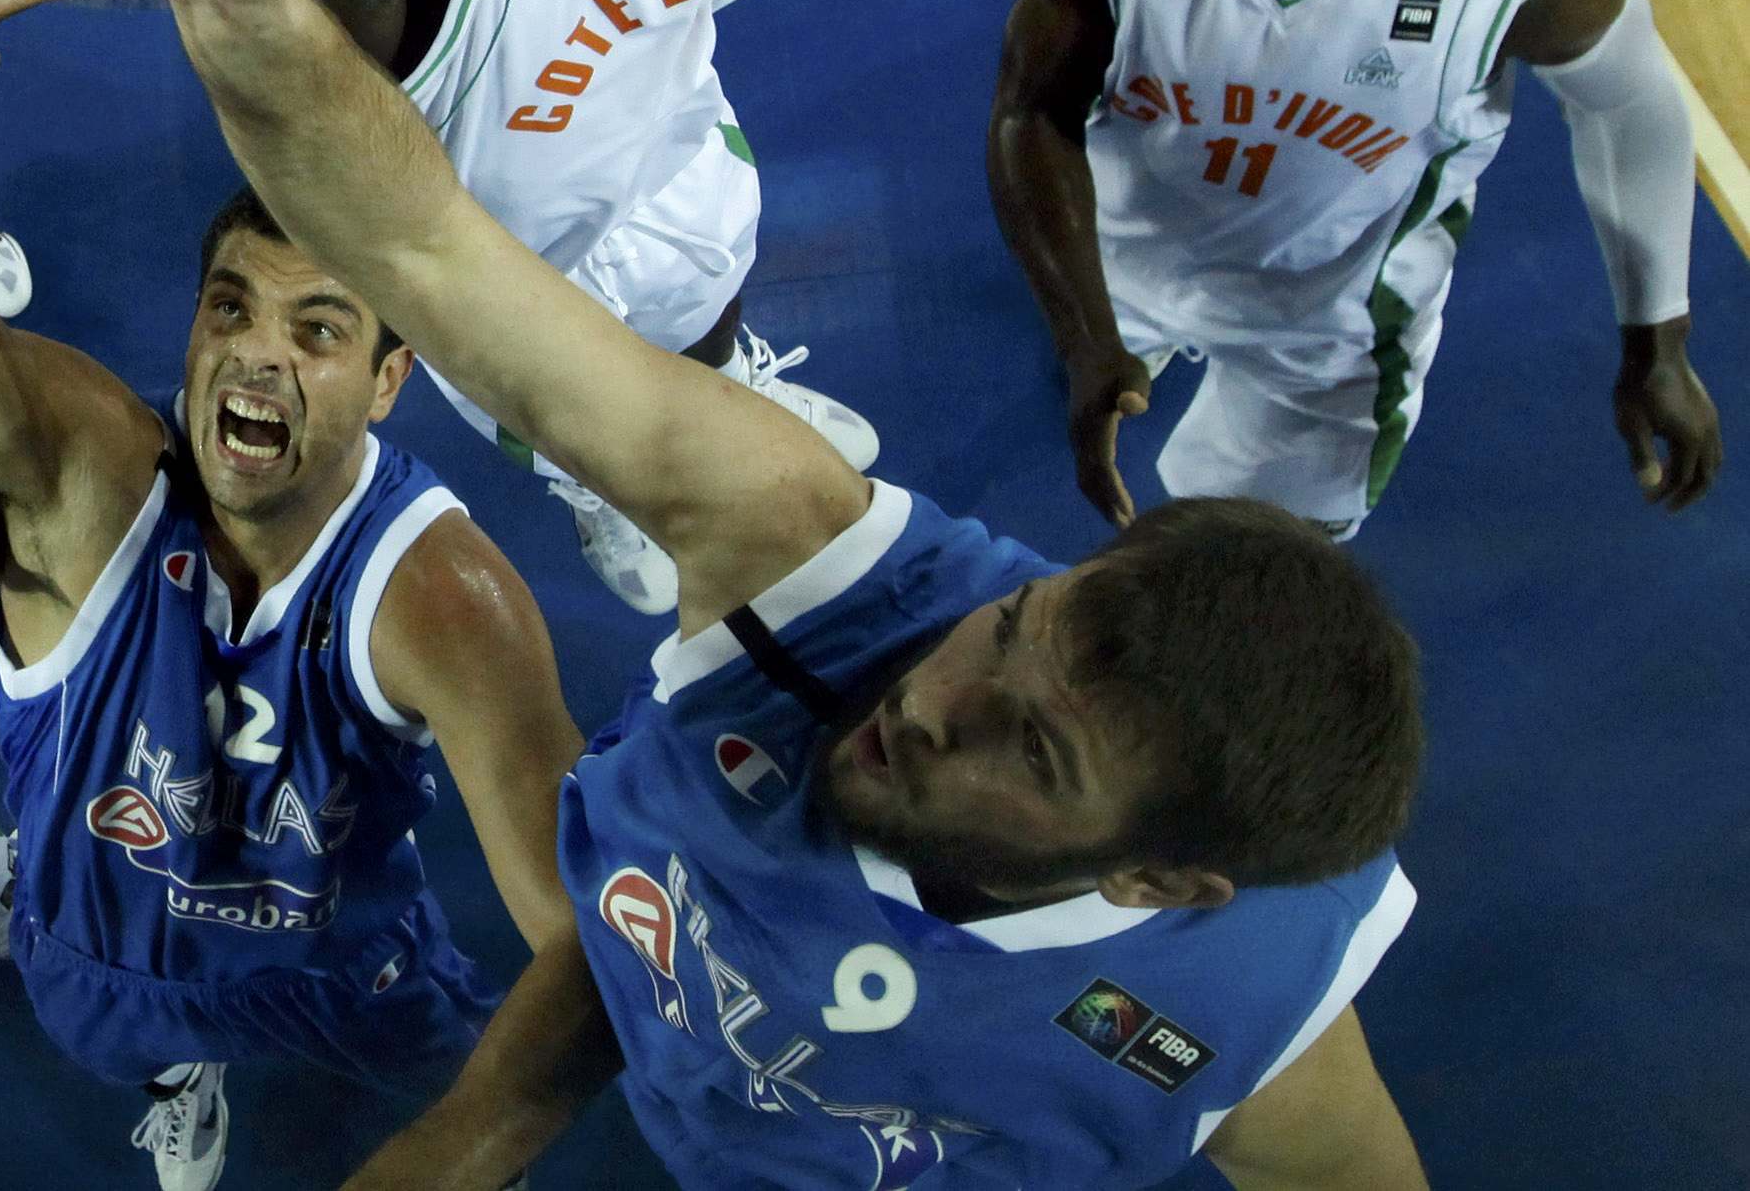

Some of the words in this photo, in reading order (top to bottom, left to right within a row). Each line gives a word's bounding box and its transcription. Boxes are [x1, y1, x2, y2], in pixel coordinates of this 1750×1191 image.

[1399, 8, 1433, 25] FIBA
[1202, 135, 1278, 198] 11
[1147, 1027, 1201, 1067] FIBA
